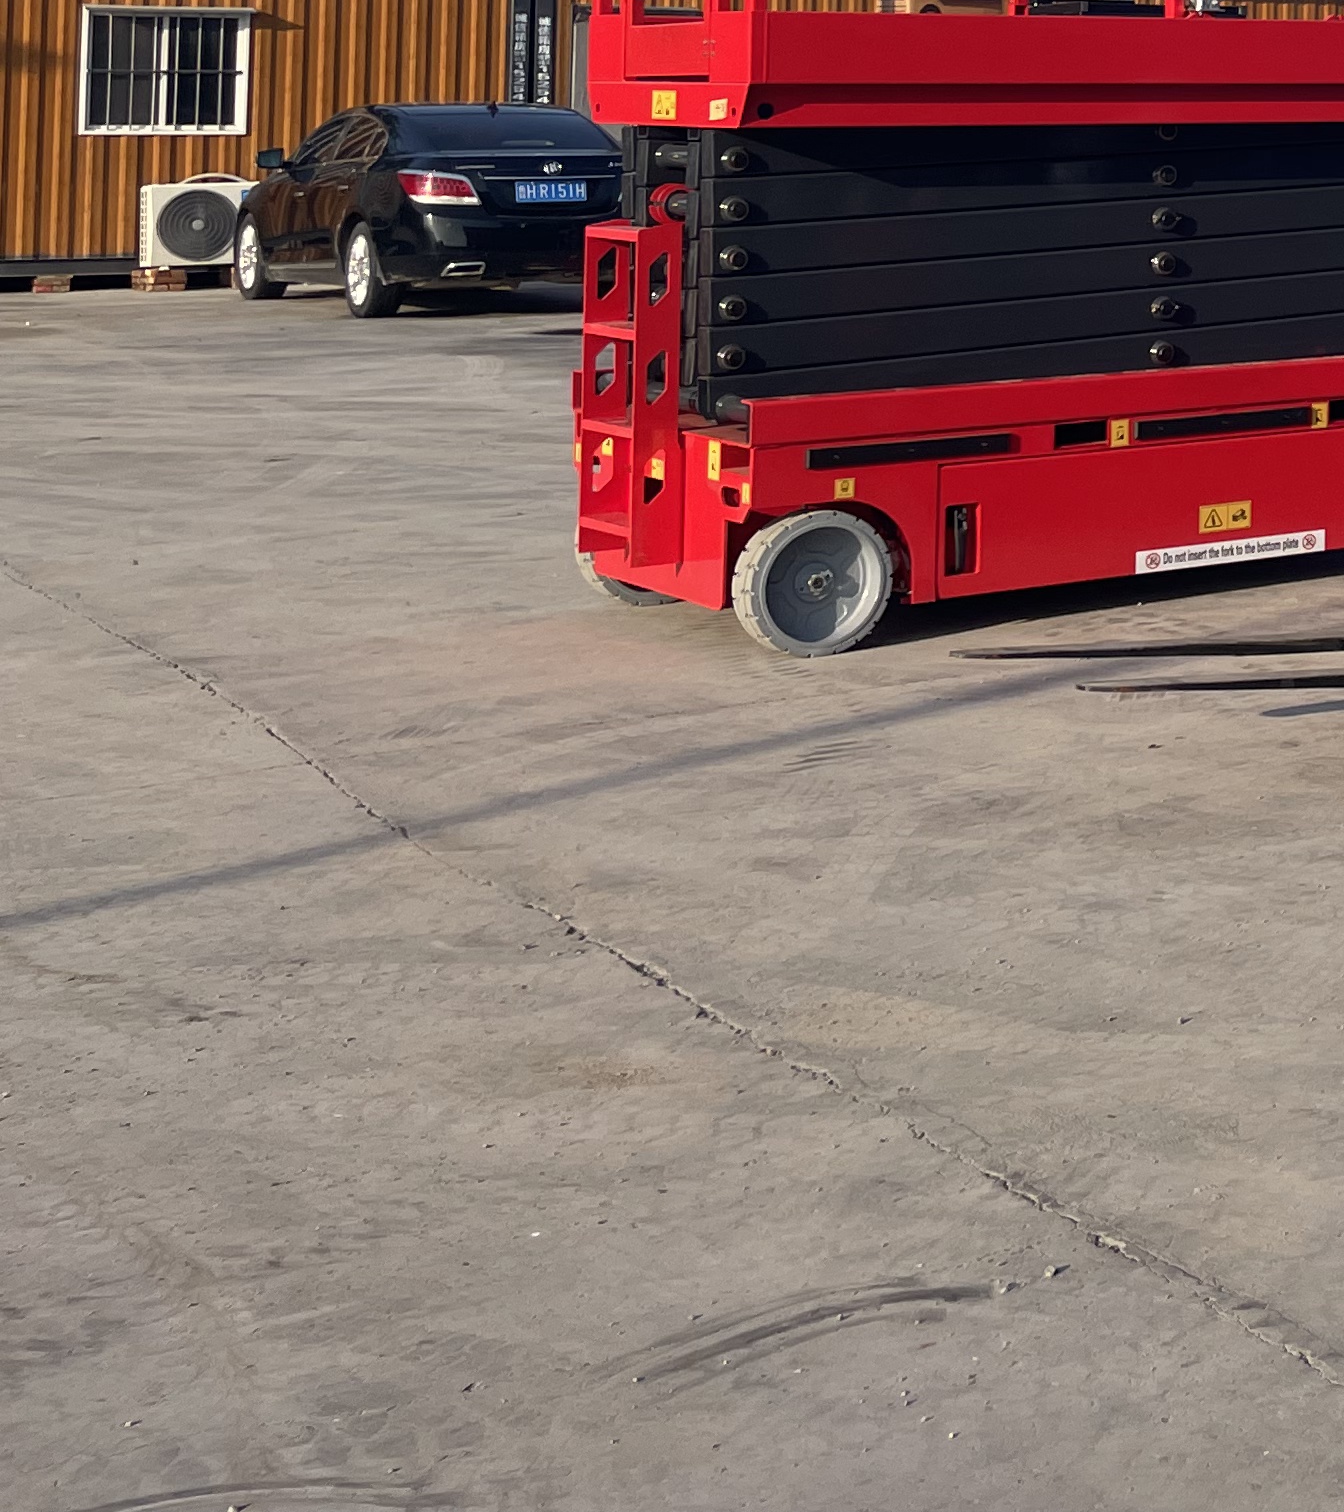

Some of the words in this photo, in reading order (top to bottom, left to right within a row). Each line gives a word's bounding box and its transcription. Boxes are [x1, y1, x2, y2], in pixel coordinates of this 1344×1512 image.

[1163, 552, 1173, 565] Do
[1175, 551, 1186, 563] not
[1209, 547, 1220, 559] the
[1221, 544, 1235, 557] fork
[1236, 545, 1243, 556] to
[1245, 543, 1256, 555] the
[1257, 541, 1281, 553] bottom
